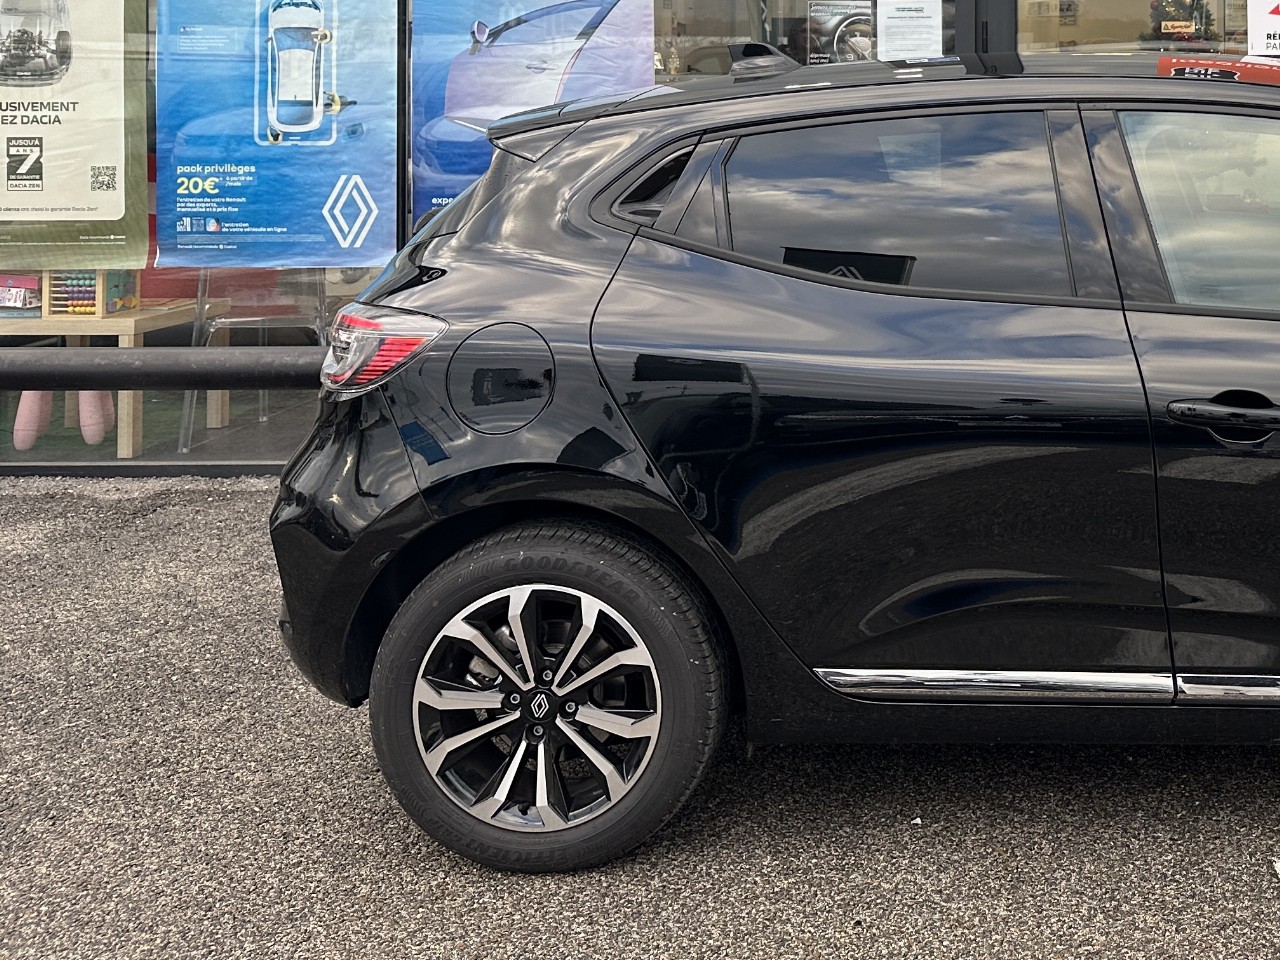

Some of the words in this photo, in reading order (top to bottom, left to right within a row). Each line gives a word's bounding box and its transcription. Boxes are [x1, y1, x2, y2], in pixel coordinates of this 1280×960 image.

[0, 114, 18, 125] EZ
[20, 114, 62, 125] DACIA
[177, 164, 203, 175] pack
[204, 163, 256, 175] privilèges
